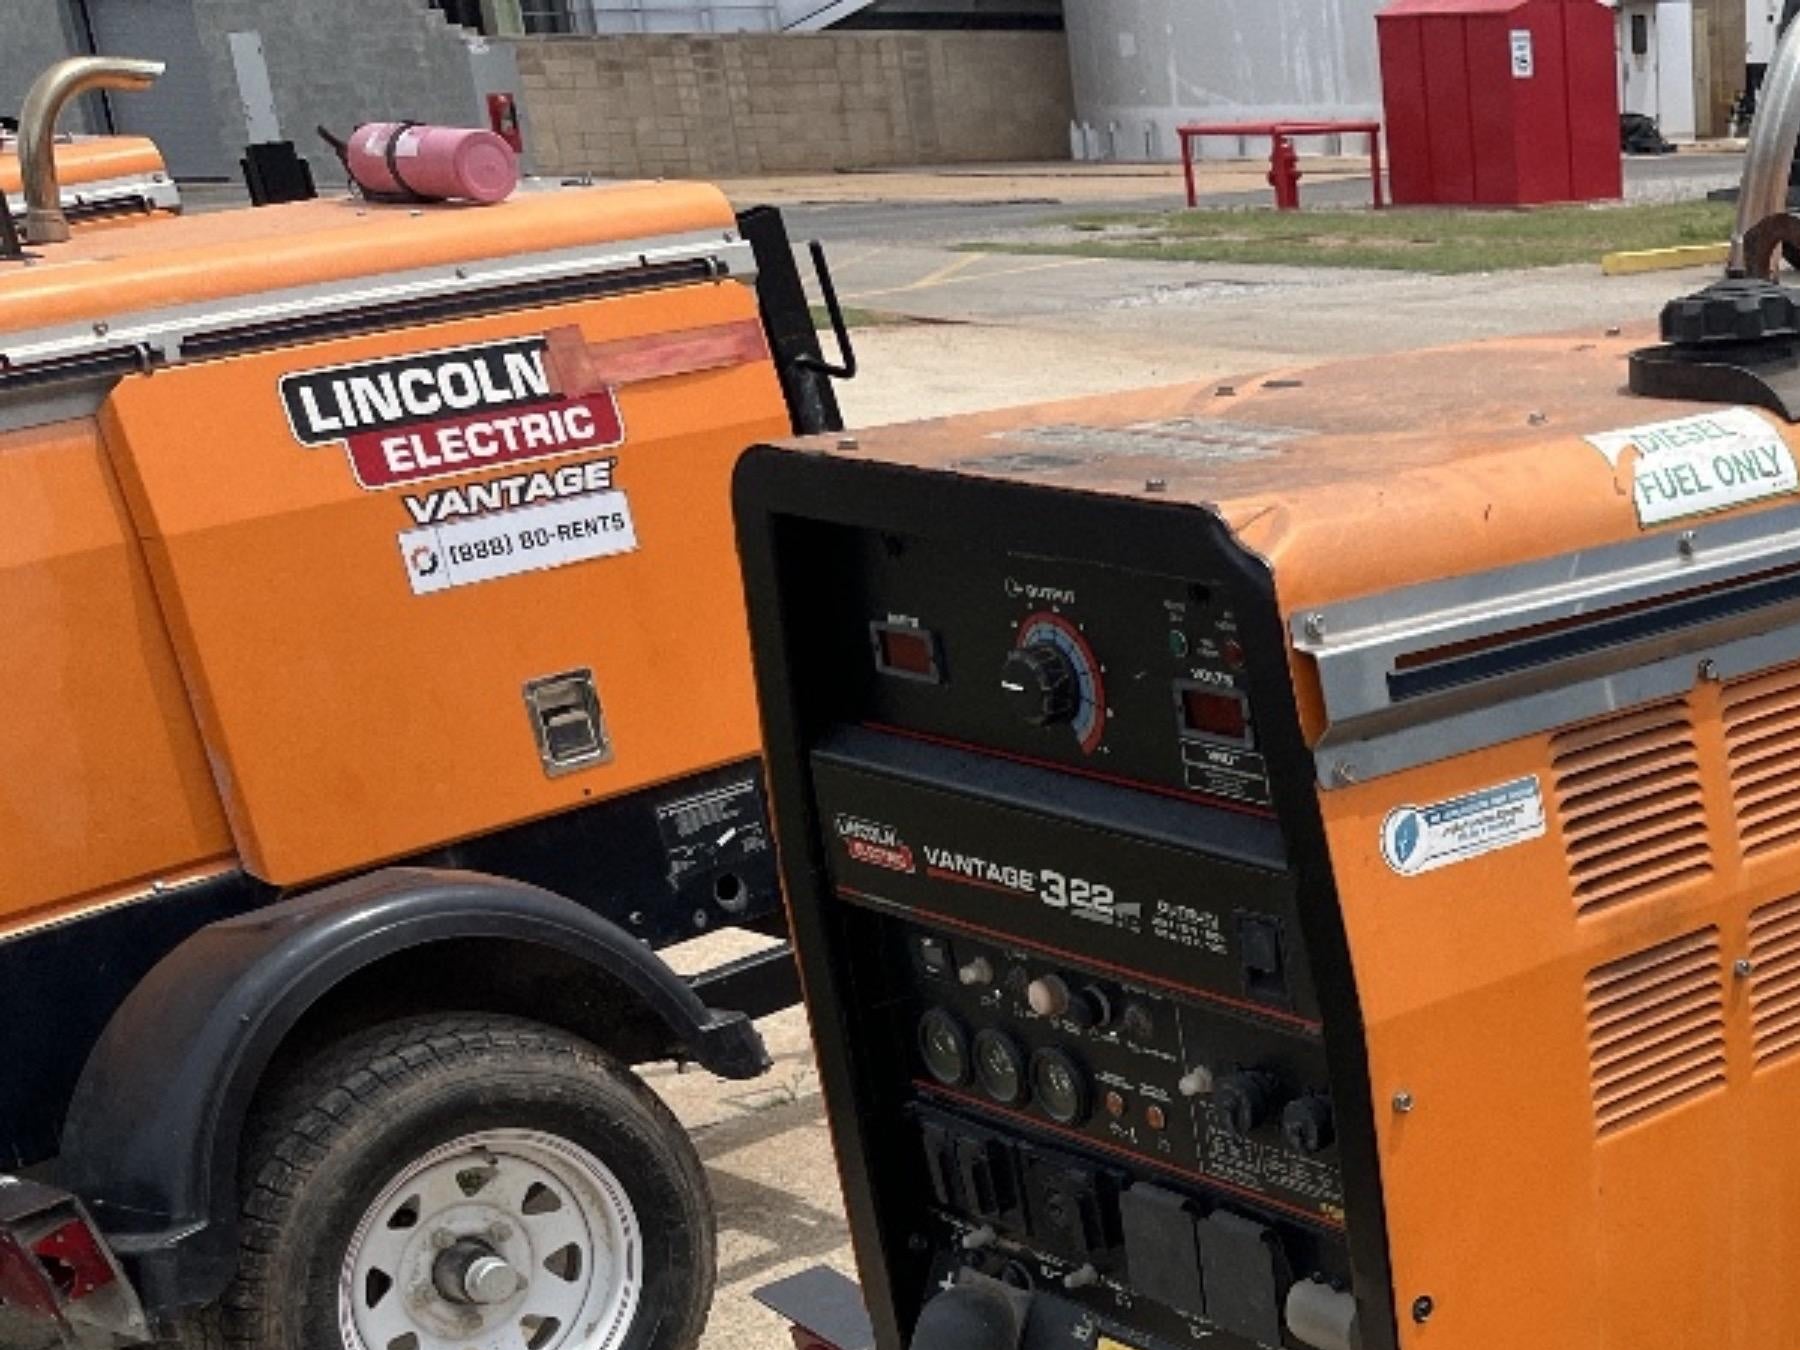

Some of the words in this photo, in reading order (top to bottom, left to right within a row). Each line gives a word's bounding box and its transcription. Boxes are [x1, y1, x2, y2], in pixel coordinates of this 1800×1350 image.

[300, 349, 549, 433] LINCOLN
[380, 405, 596, 473] ELECTRIC
[1630, 419, 1737, 454] DIESEL
[403, 458, 617, 525] VANTAGE
[1637, 462, 1713, 504] FUEL
[1713, 444, 1782, 487] ONLY
[449, 533, 514, 565] (888)
[923, 845, 1037, 893] VANTAGE
[1039, 868, 1115, 911] 322
